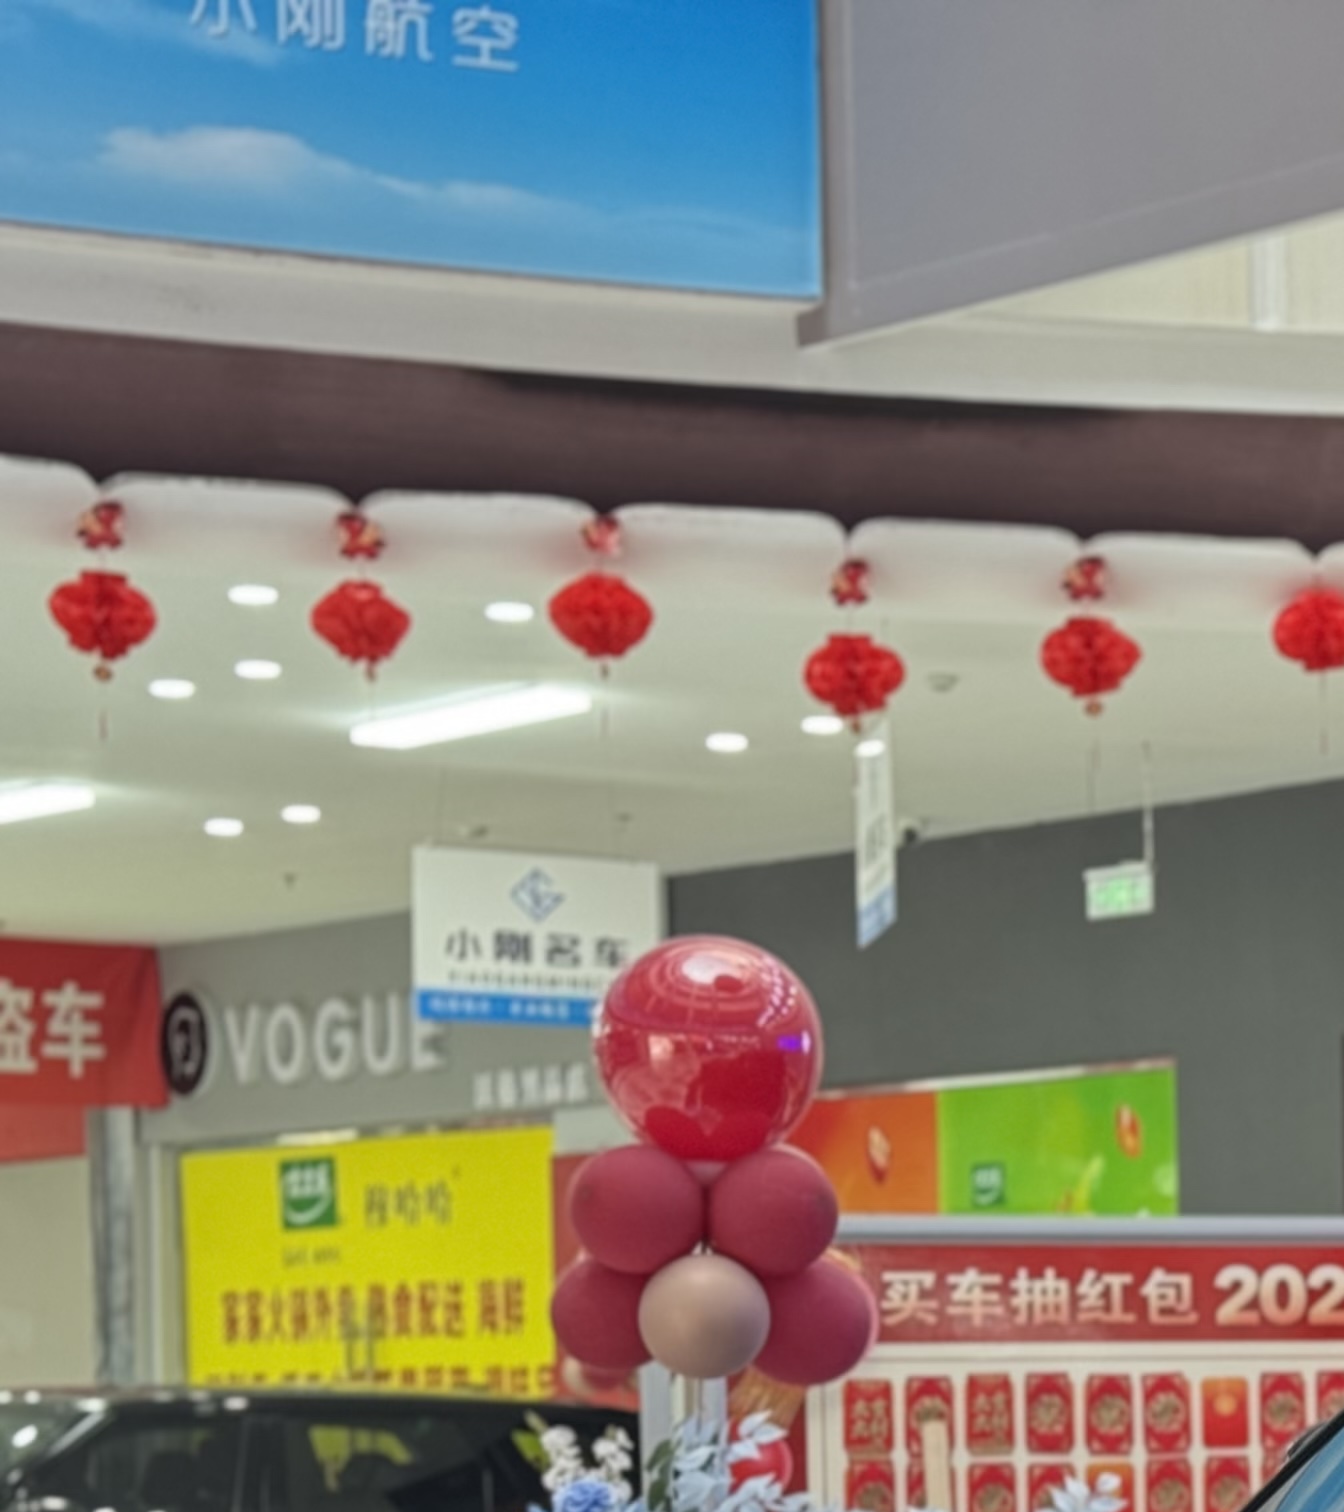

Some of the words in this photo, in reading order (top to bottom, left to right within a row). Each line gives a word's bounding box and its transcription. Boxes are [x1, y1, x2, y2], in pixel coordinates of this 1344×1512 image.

[189, 0, 519, 72] 小刚航空
[224, 993, 448, 1084] VOGUE
[881, 1265, 1198, 1326] 买车抽红包
